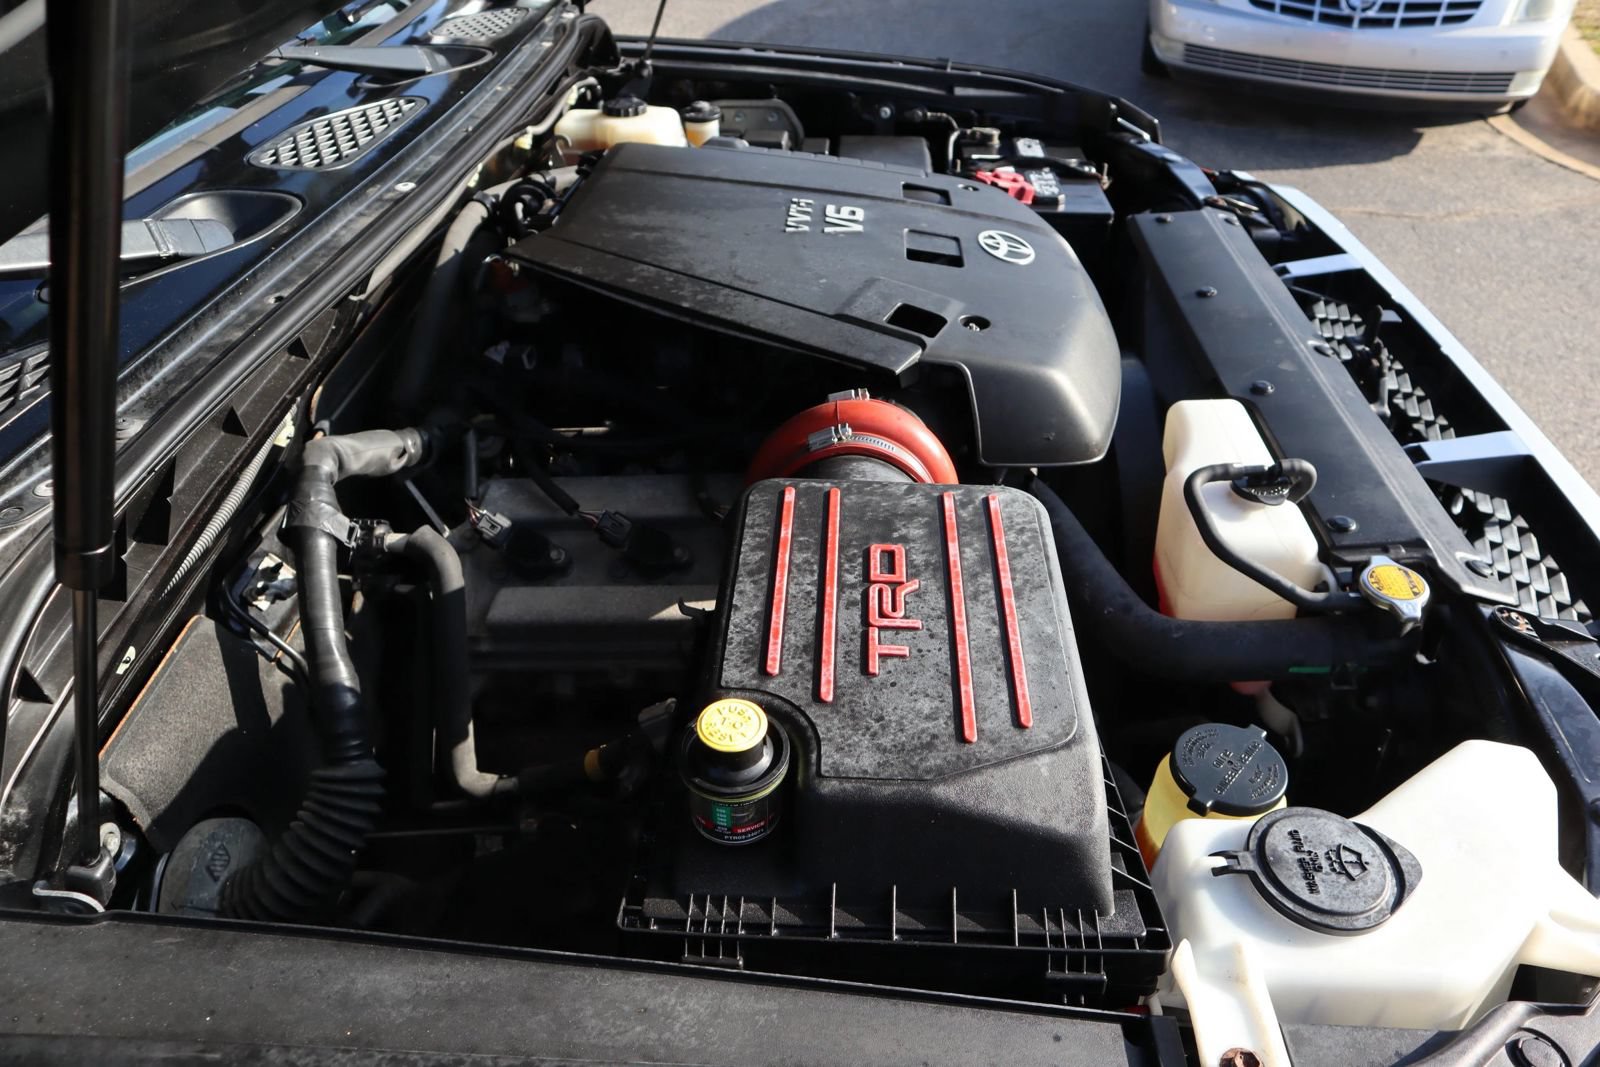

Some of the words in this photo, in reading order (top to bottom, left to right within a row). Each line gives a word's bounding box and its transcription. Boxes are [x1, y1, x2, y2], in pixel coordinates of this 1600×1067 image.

[824, 204, 864, 233] V6
[868, 544, 924, 676] TRD
[737, 820, 765, 833] SERVICE
